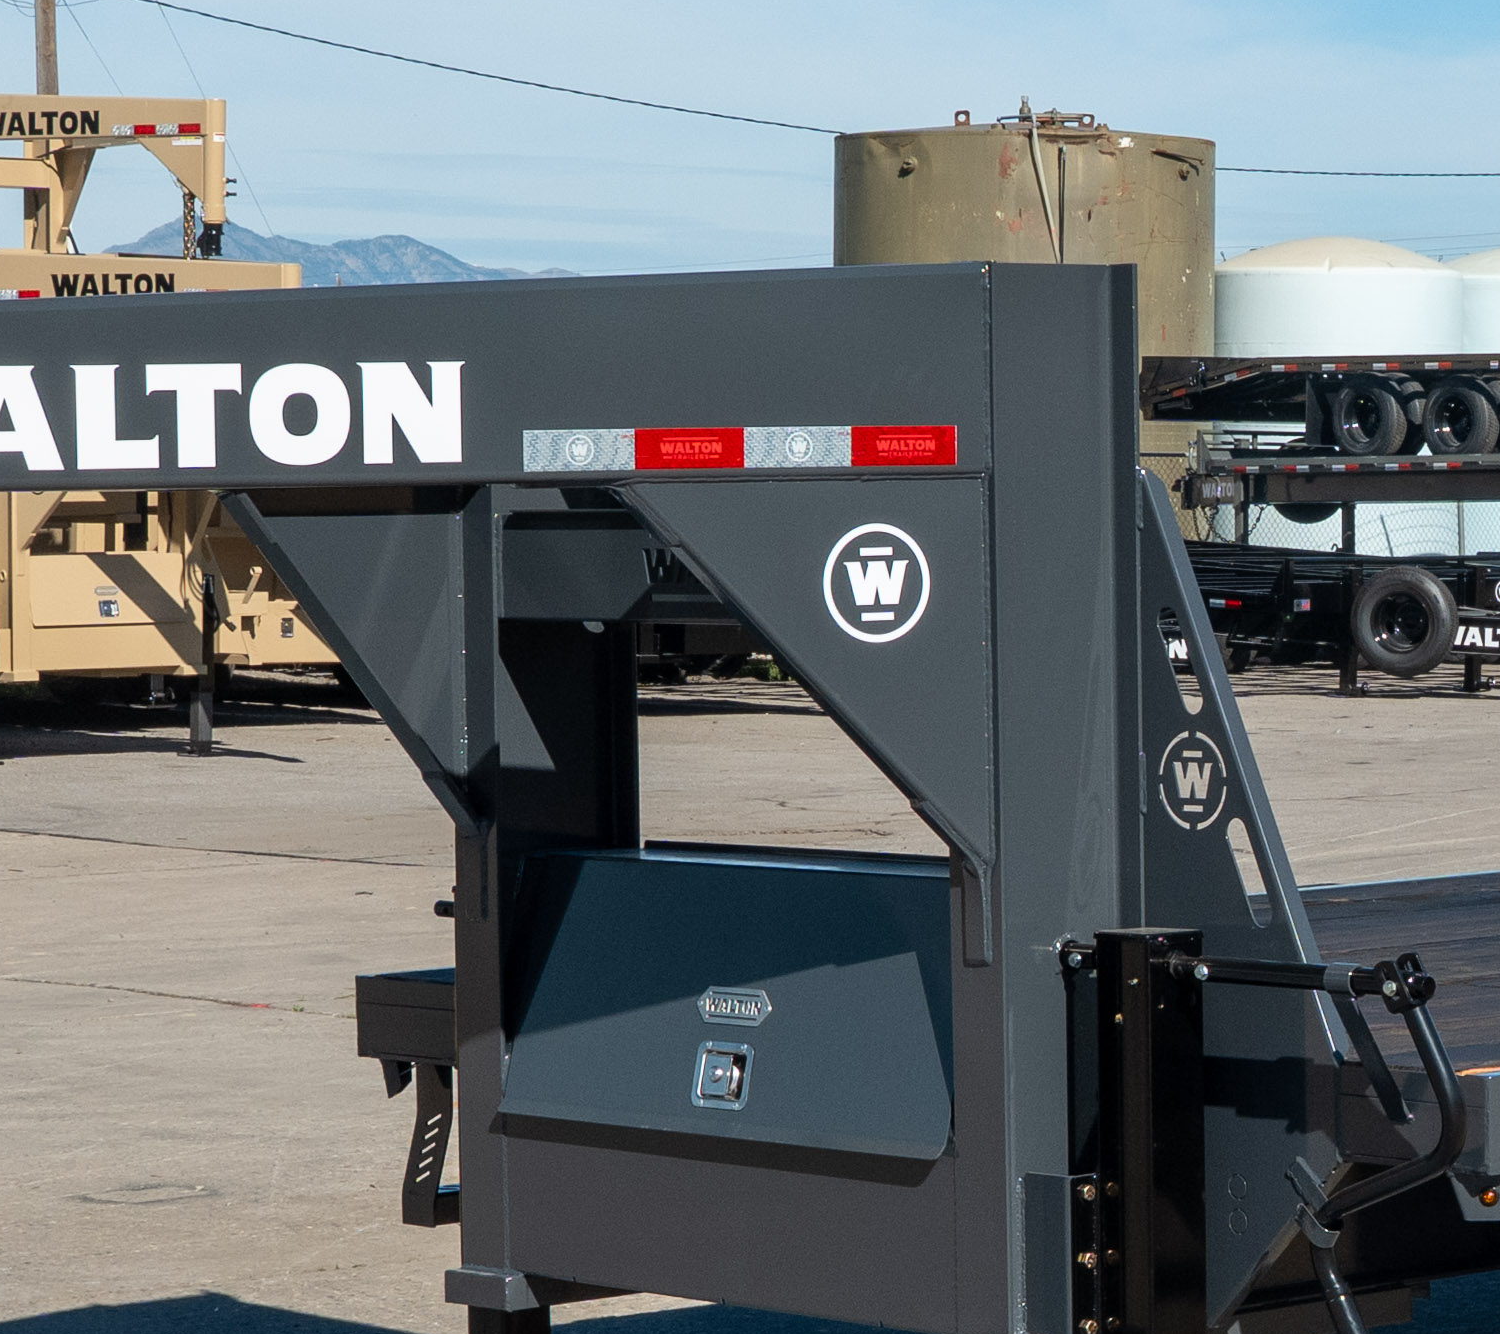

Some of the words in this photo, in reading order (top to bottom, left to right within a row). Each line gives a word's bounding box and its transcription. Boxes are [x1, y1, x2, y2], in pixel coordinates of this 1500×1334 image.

[50, 273, 175, 297] WALTON
[660, 441, 723, 454] WALTON
[876, 439, 936, 452] WALTON
[705, 997, 762, 1016] WALTON
